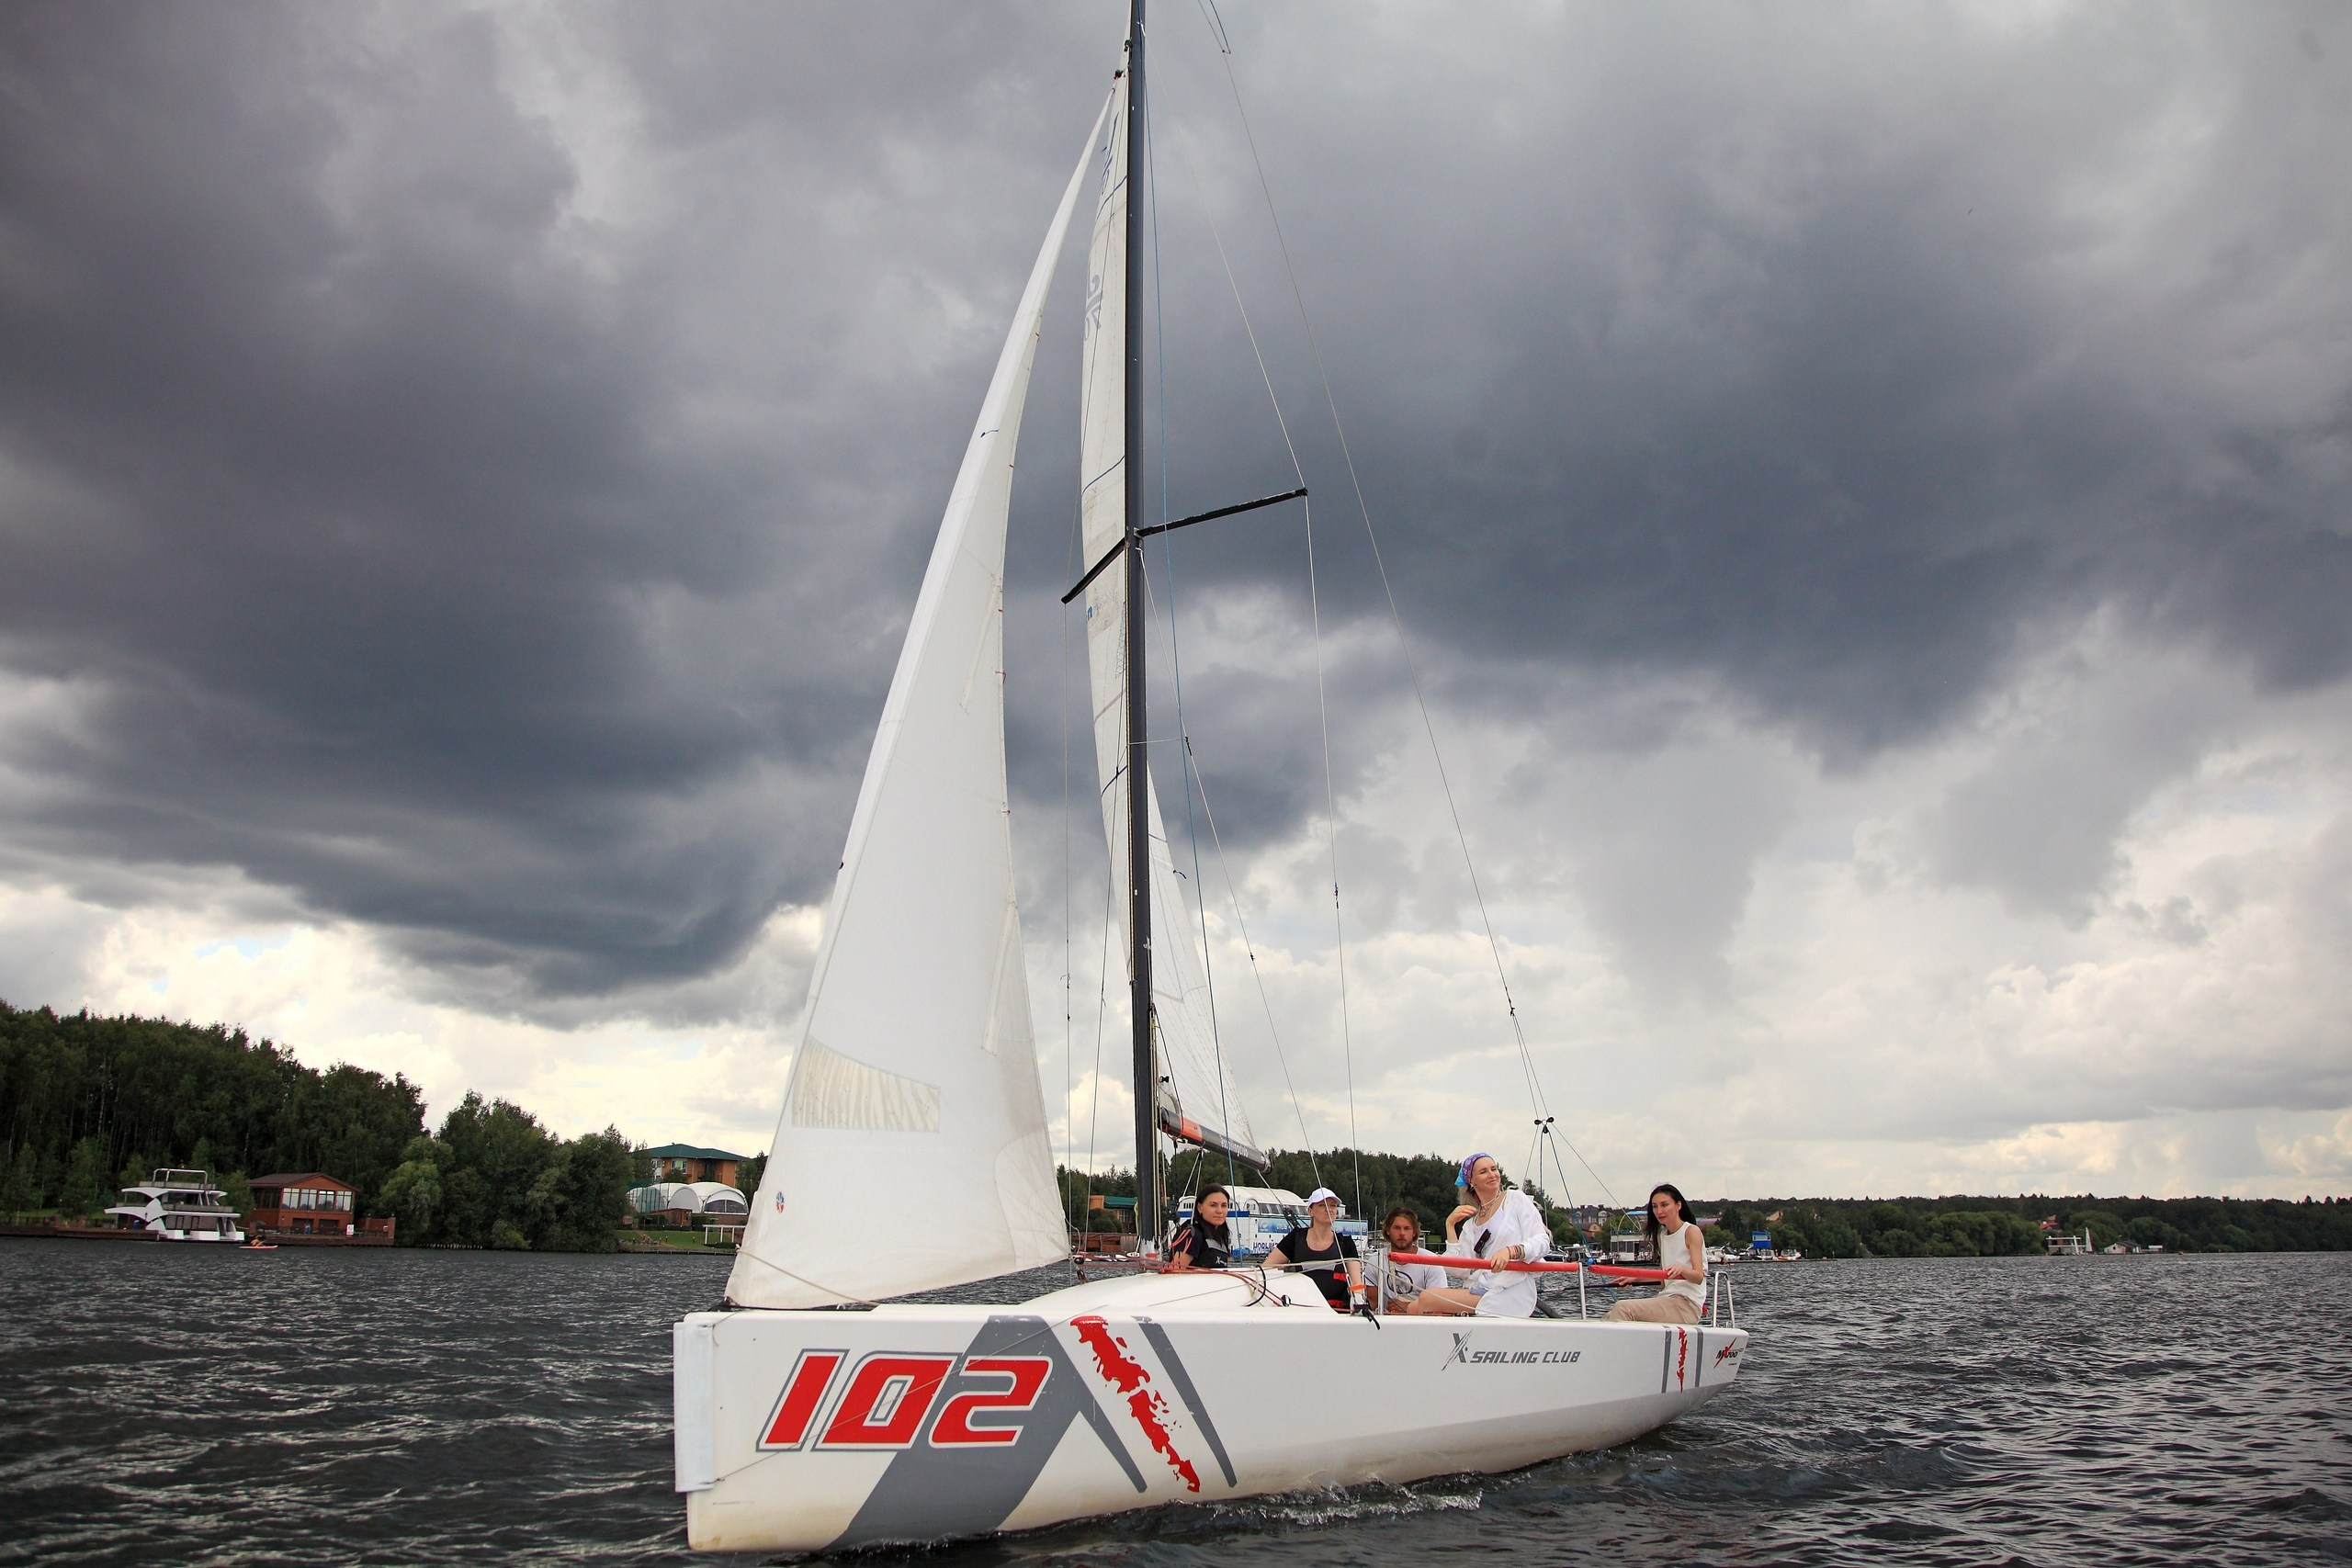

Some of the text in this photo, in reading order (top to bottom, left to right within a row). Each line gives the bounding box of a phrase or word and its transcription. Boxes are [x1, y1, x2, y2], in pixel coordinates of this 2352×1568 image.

[1470, 1350, 1540, 1364] SAILING
[1542, 1350, 1581, 1363] CLUB
[756, 1348, 1053, 1452] 102
